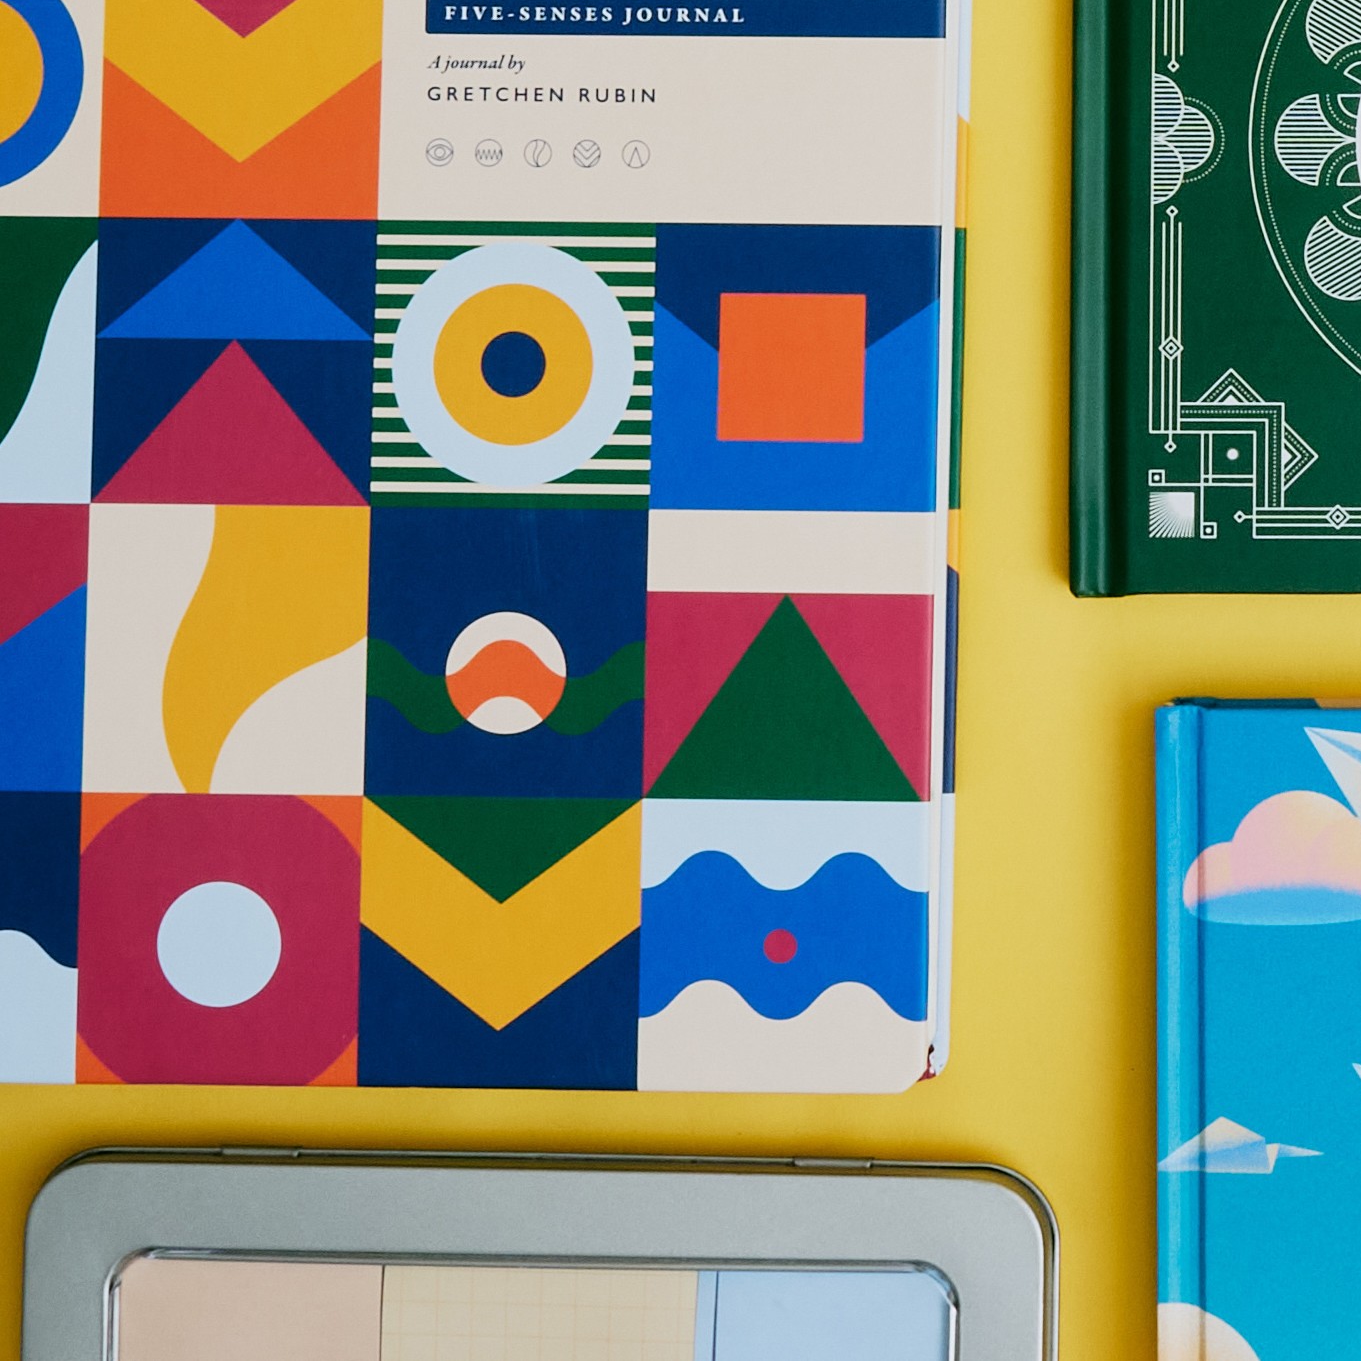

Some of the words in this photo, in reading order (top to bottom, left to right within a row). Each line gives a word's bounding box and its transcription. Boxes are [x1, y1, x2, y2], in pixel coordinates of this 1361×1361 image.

[445, 6, 612, 21] FIVE-SENSES
[622, 8, 744, 25] JOURNAL
[428, 56, 440, 68] A
[441, 55, 505, 73] journal
[508, 55, 525, 74] by
[428, 87, 563, 102] GRETCHEN
[580, 88, 655, 102] RUBIN
